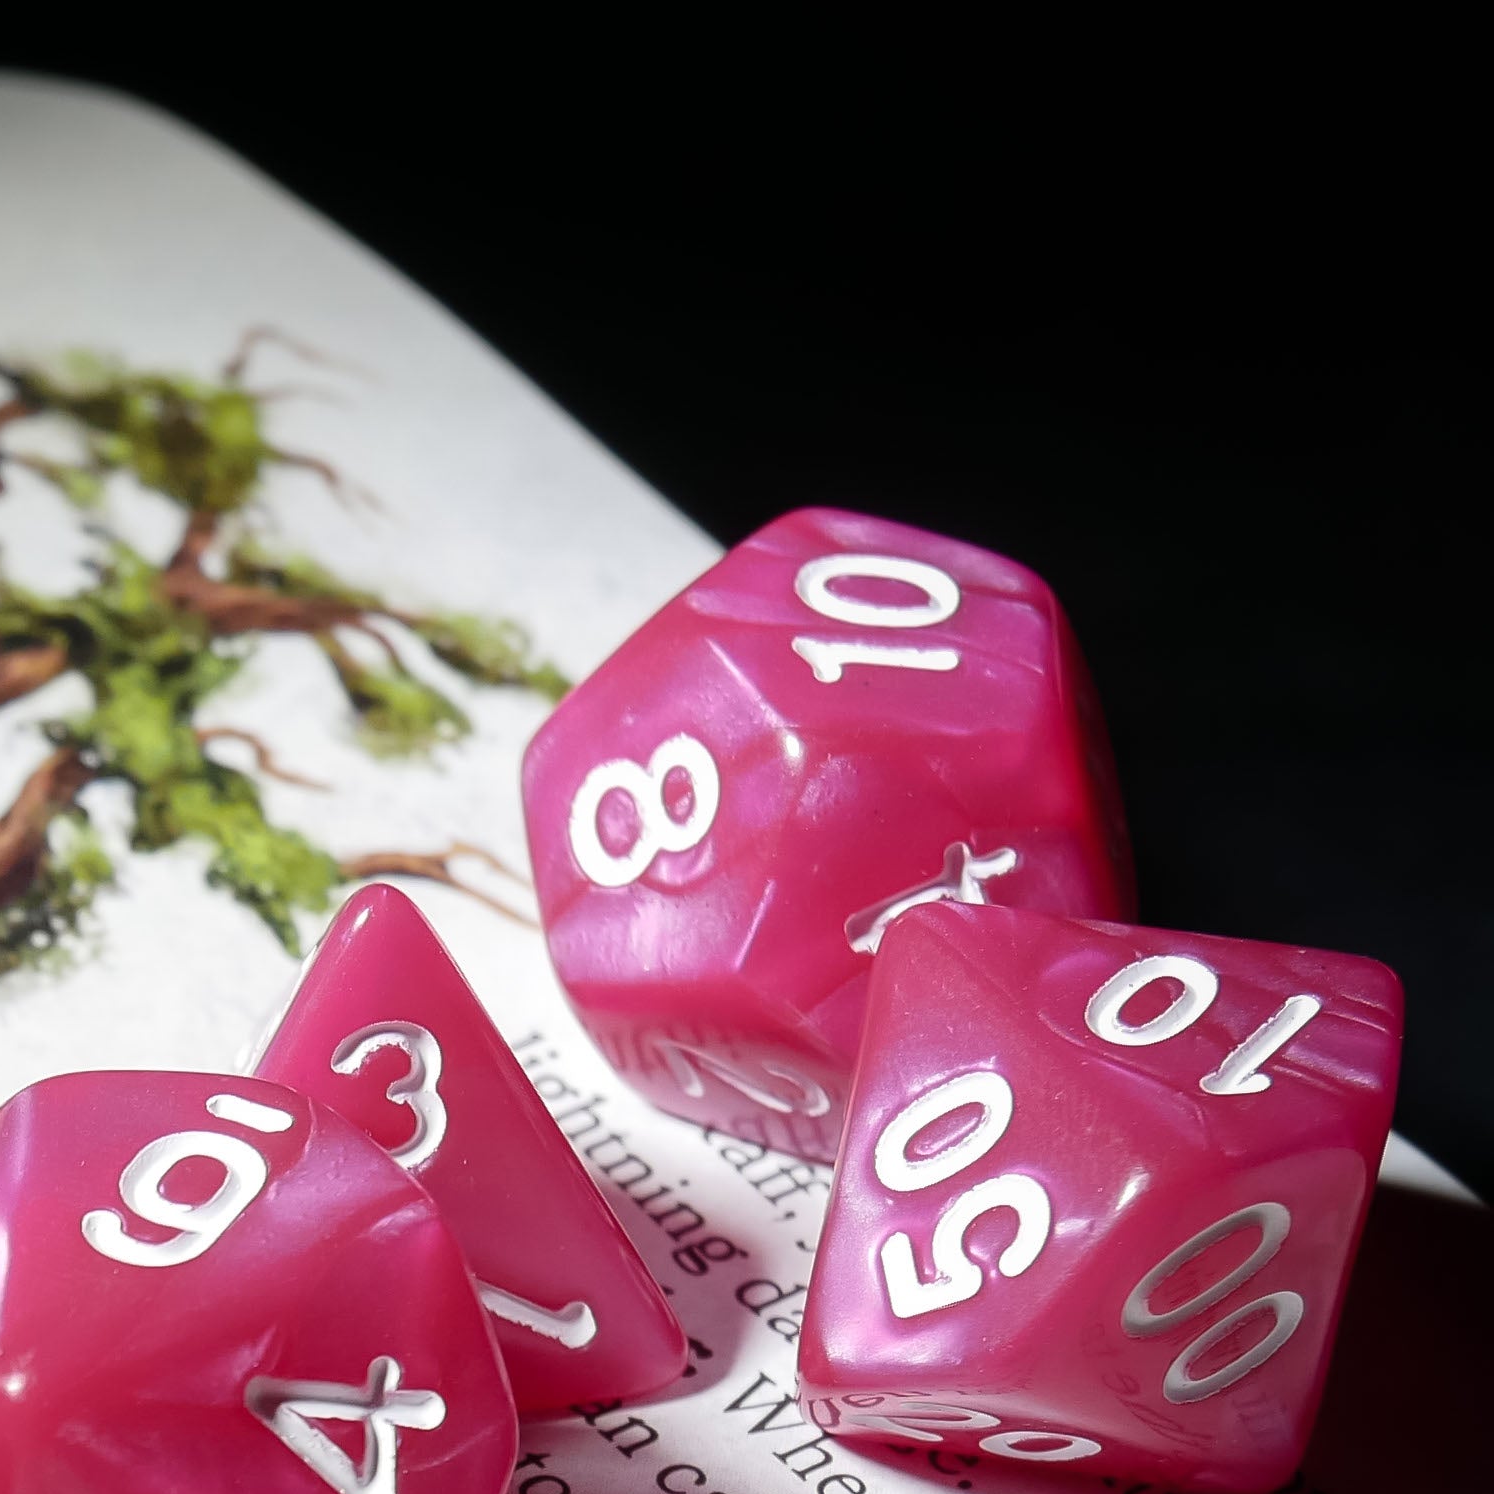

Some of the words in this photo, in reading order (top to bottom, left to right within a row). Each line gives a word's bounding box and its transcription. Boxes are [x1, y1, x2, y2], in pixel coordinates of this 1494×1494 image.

[792, 554, 961, 684] 10
[569, 734, 720, 888] 8
[874, 1071, 1052, 1319] 50
[1120, 1201, 1305, 1405] 00
